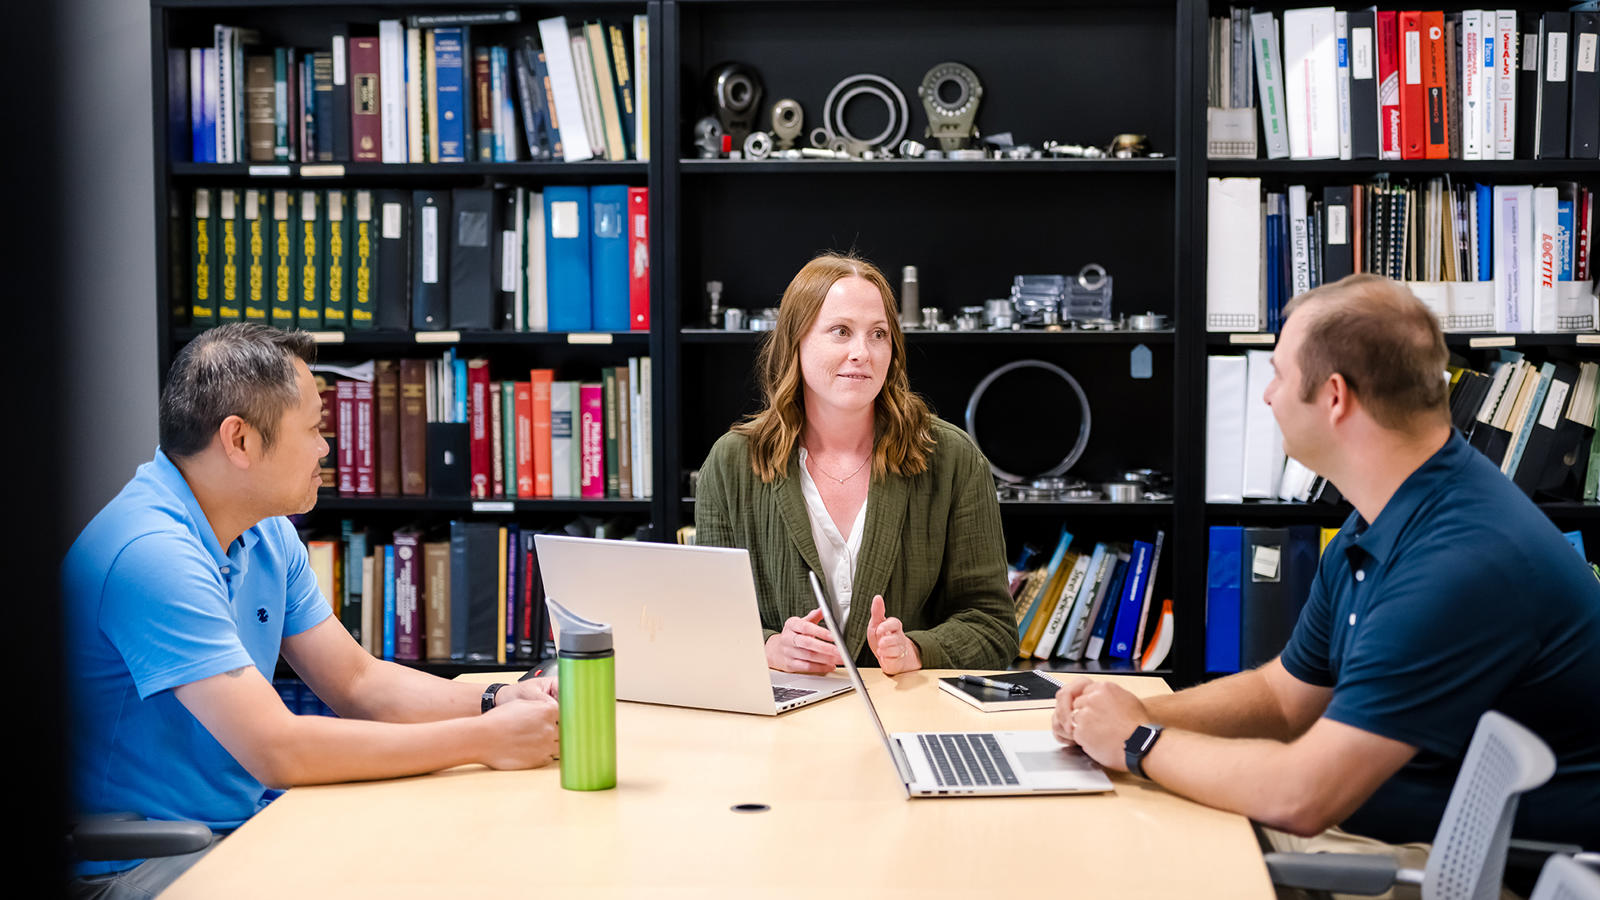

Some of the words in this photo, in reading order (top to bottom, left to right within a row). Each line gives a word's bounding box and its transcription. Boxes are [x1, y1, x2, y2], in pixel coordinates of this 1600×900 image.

[1502, 33, 1510, 75] SEALS
[1295, 218, 1305, 258] Failure
[1542, 233, 1553, 289] LOCTITE
